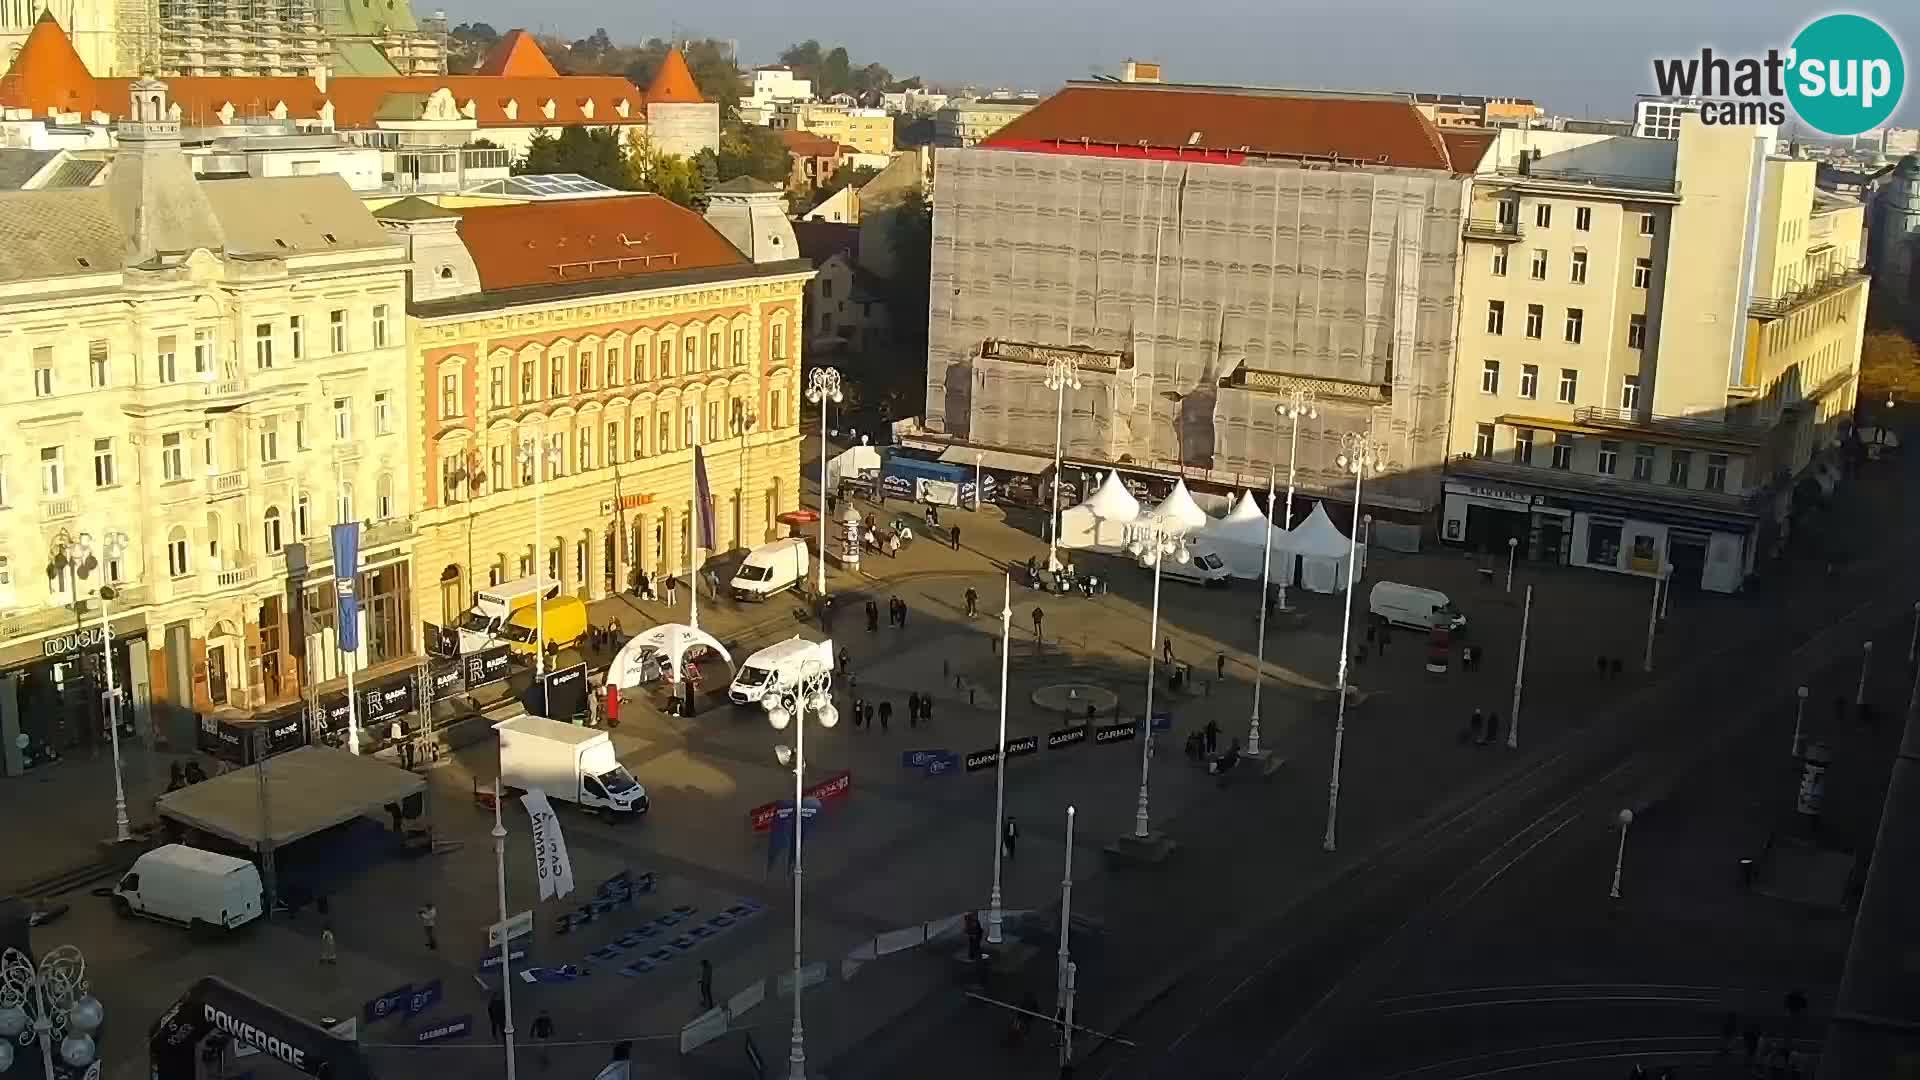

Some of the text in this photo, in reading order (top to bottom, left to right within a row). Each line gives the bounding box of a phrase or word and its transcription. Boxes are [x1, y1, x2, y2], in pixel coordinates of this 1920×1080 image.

[44, 623, 116, 656] DOUGLAS
[1049, 729, 1084, 746] GARMIN
[1096, 727, 1135, 742] GARMIN
[203, 1003, 306, 1071] POWERADE
